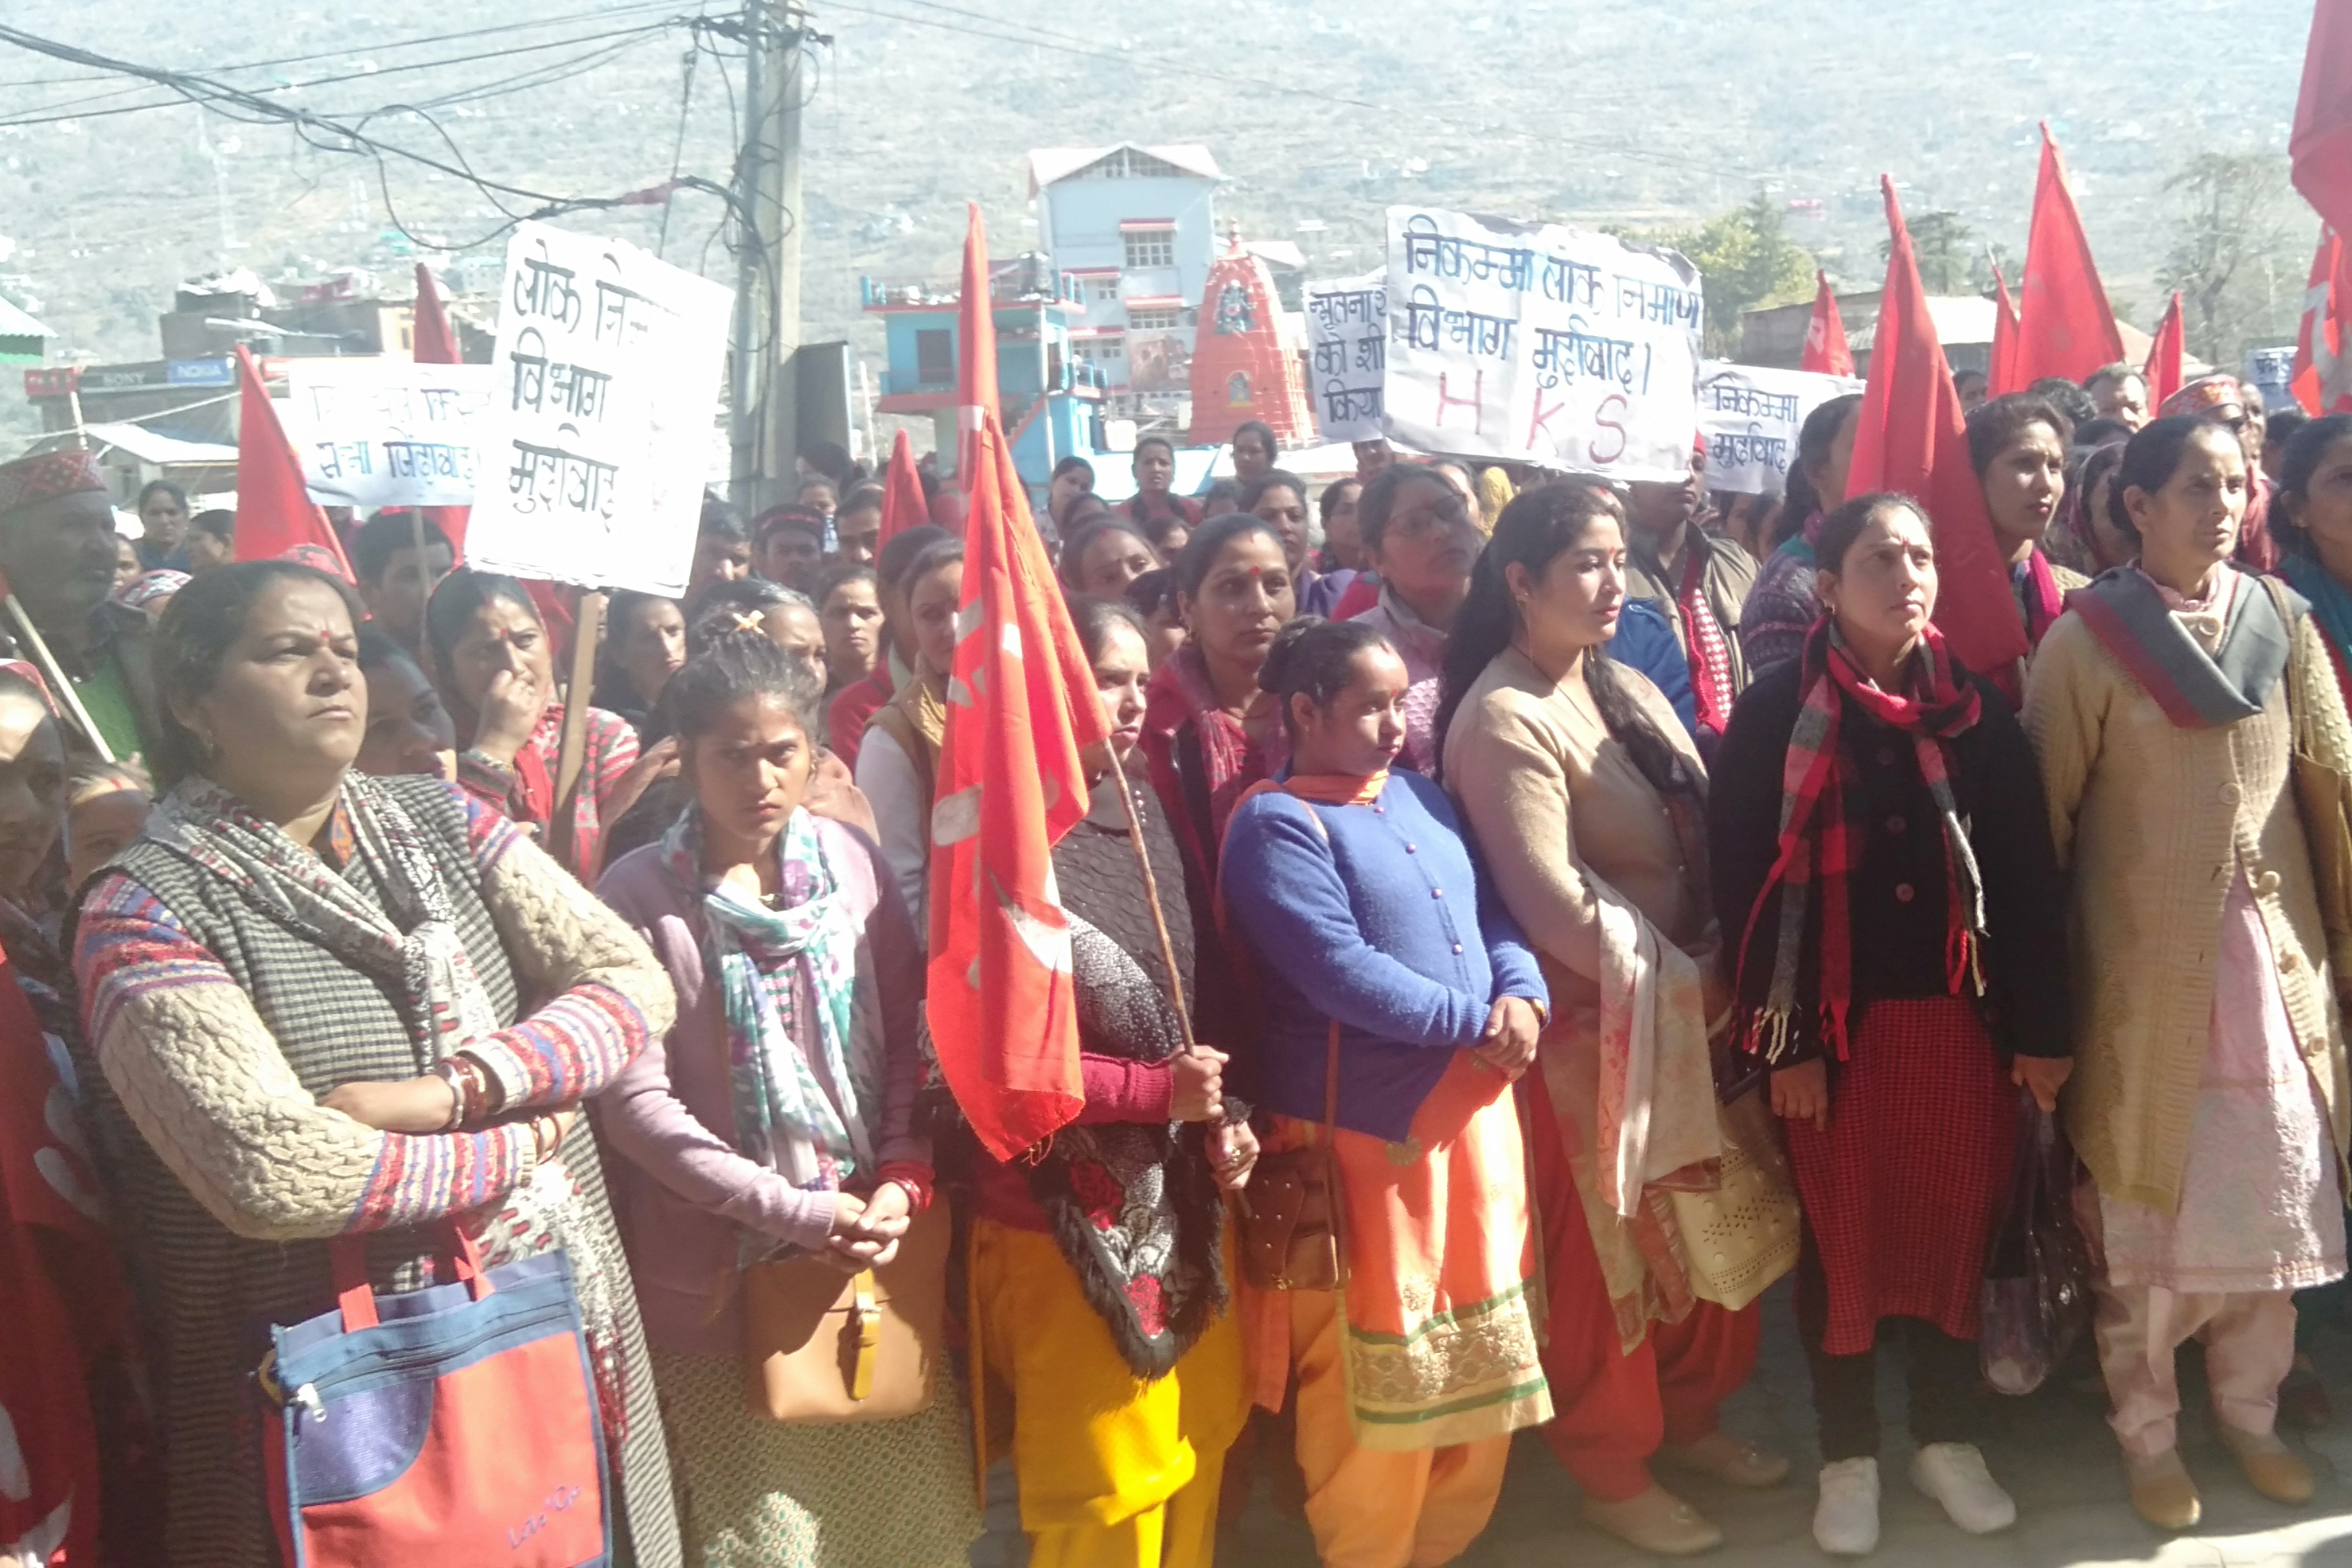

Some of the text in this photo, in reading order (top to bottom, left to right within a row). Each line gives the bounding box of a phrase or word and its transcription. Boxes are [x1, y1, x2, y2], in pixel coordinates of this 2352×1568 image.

[514, 239, 581, 333] लोक
[1402, 213, 1535, 291] निकम्मा
[1315, 332, 1348, 377] को
[1406, 283, 1518, 361] विभाग
[176, 365, 222, 378] NOKIA
[510, 326, 613, 423] विभाग
[1713, 372, 1800, 423] निकम्मा
